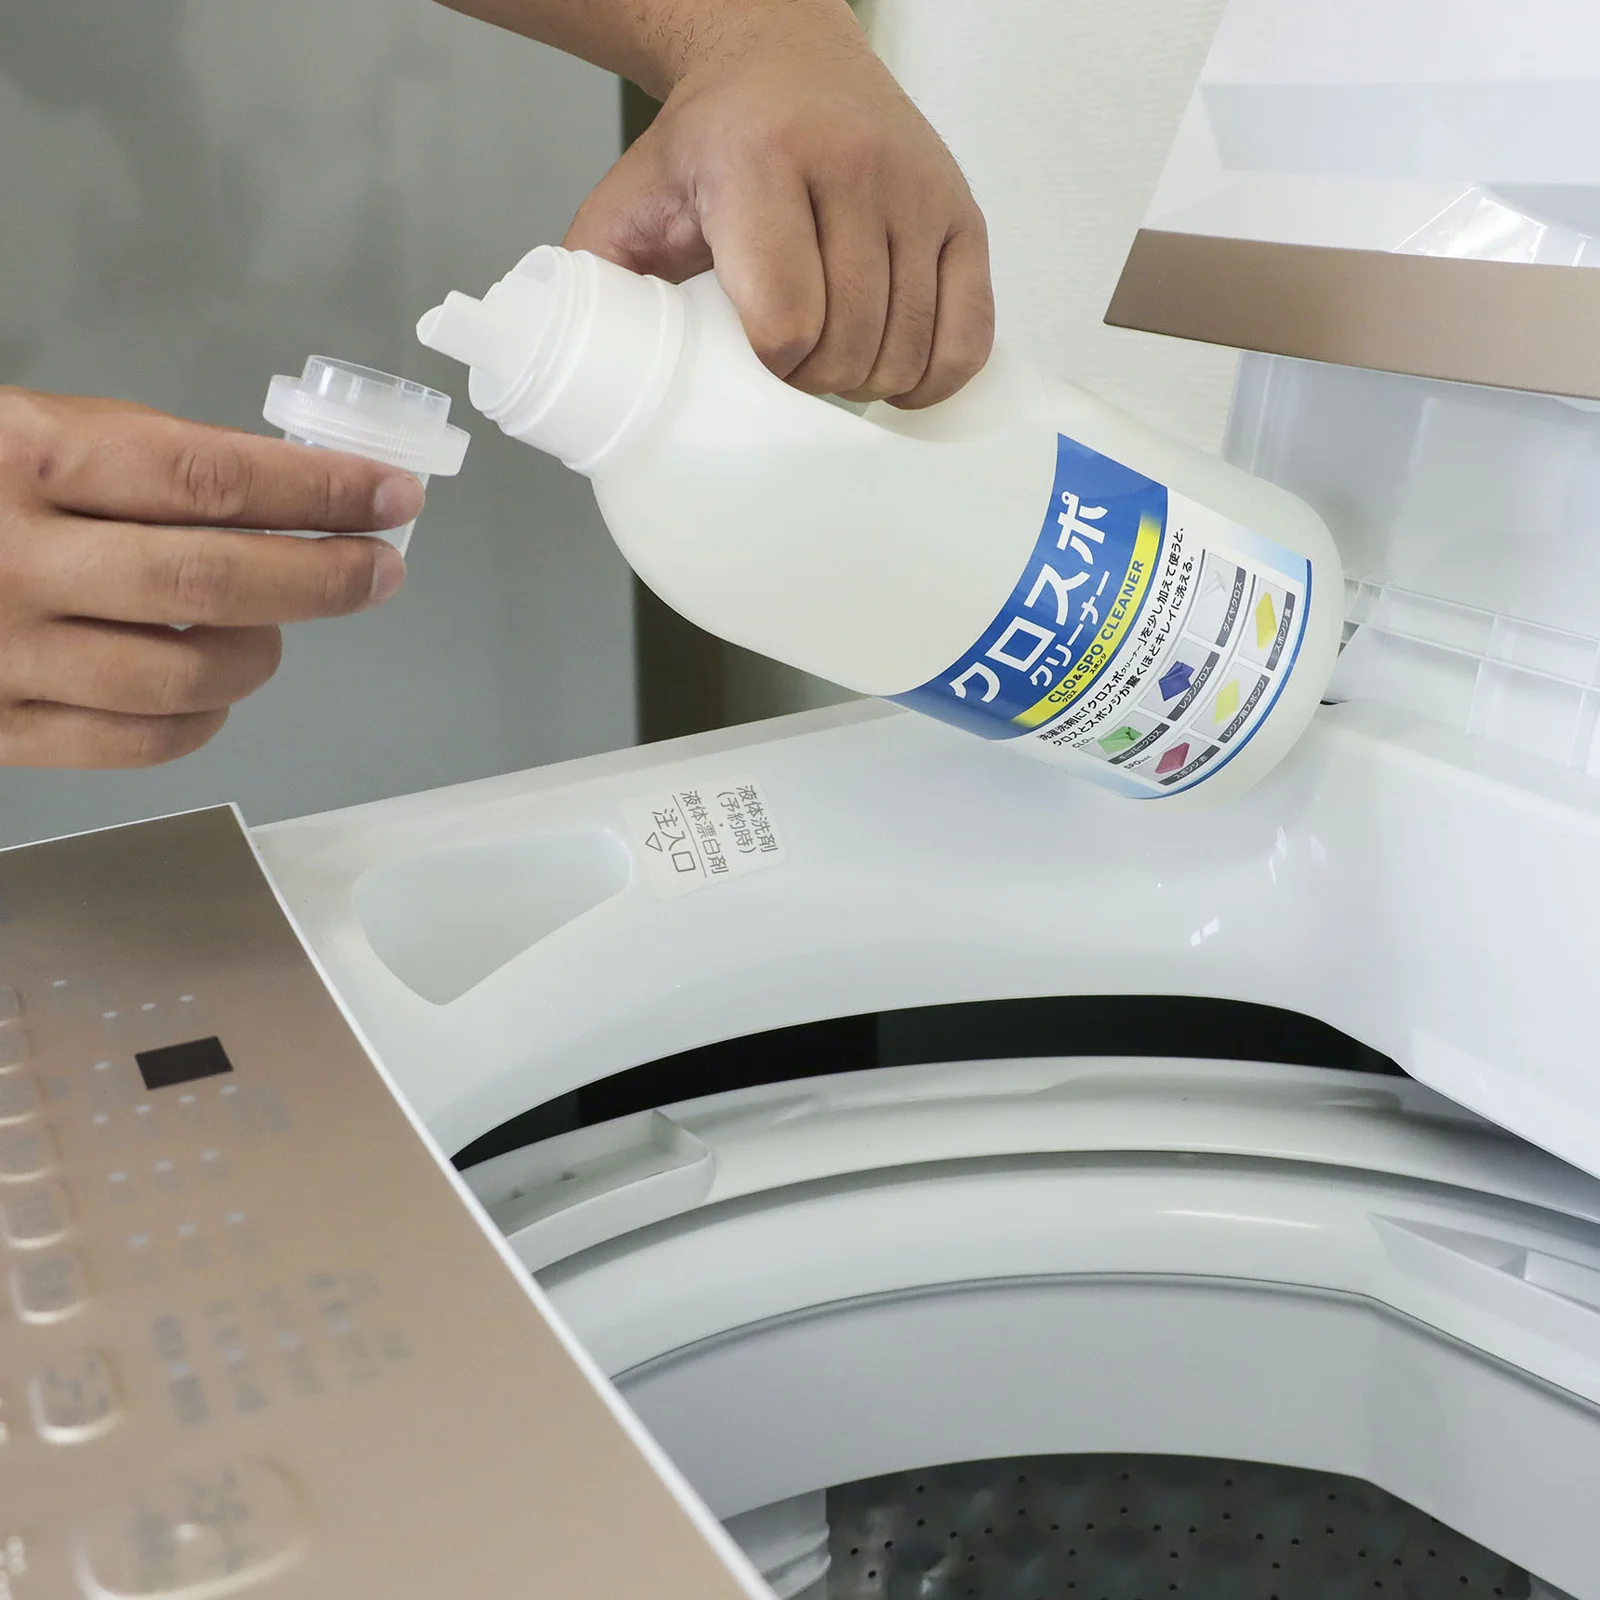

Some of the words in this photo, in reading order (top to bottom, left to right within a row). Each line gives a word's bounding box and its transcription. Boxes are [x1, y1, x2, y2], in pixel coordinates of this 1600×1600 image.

[949, 491, 1108, 703] クロスポ
[1029, 571, 1110, 687] クリーナー
[1101, 560, 1144, 641] CLEANER
[651, 808, 696, 873] 注入口
[680, 790, 729, 874] 液体漂白剤
[717, 791, 757, 854] (予約時)
[736, 785, 779, 853] 液体洗剤
